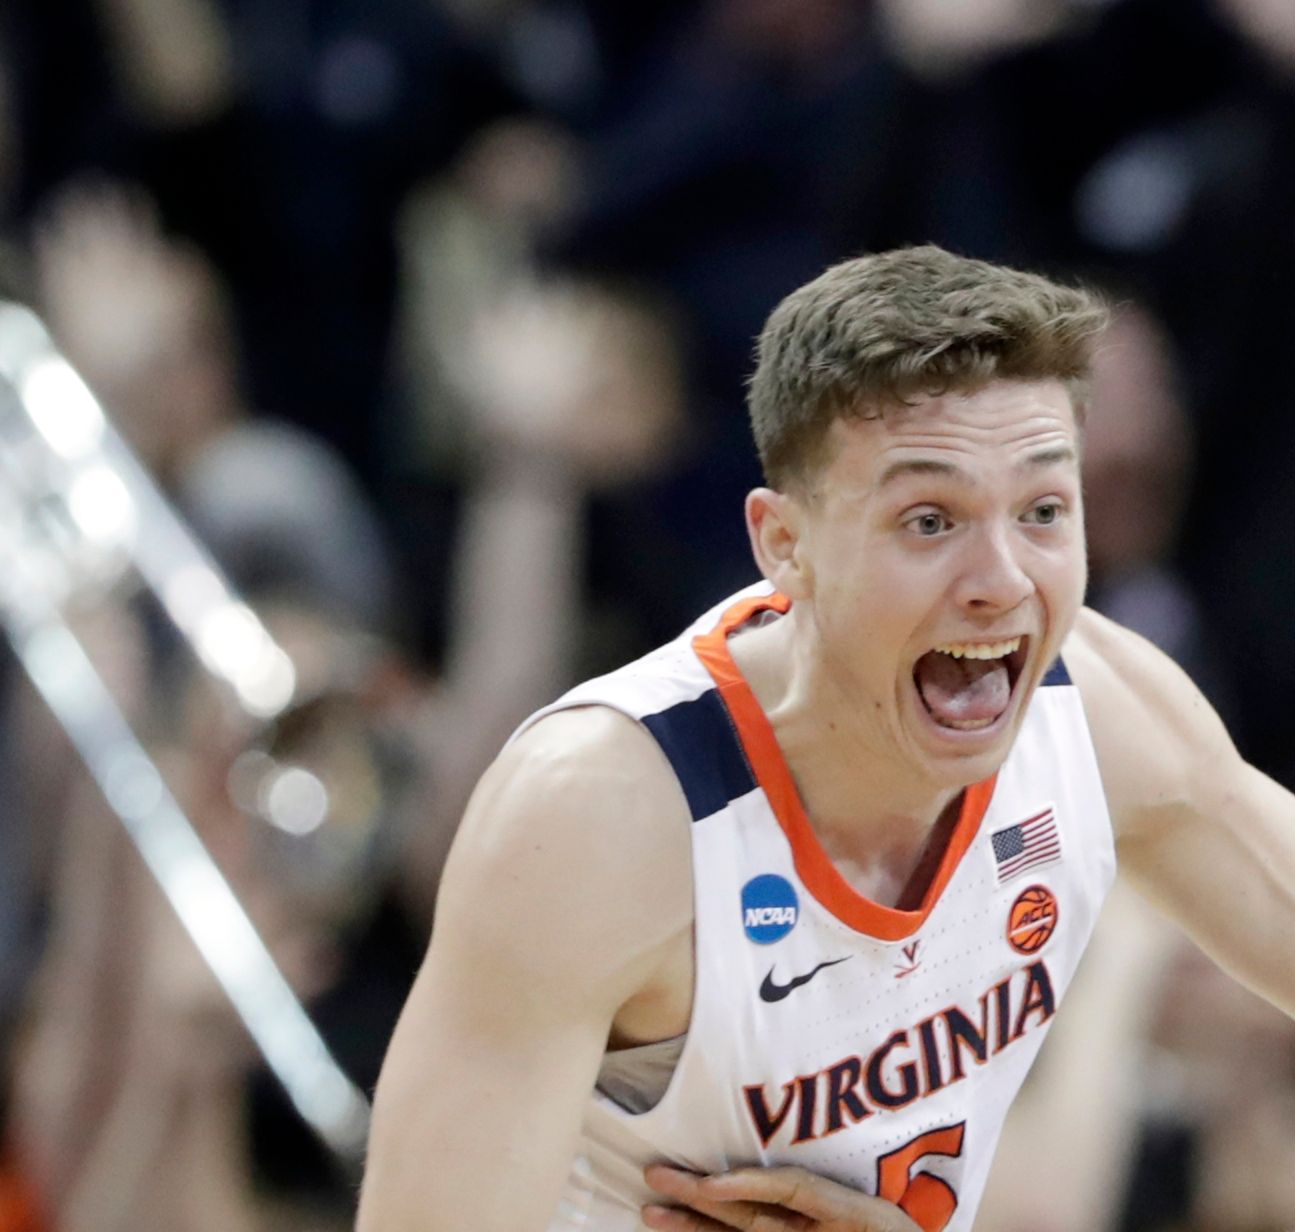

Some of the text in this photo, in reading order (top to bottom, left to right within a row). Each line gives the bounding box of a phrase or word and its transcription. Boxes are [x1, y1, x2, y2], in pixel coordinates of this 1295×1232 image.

[745, 907, 796, 927] NCAA
[1014, 901, 1053, 929] ACC
[743, 959, 1057, 1149] VIRGINIA
